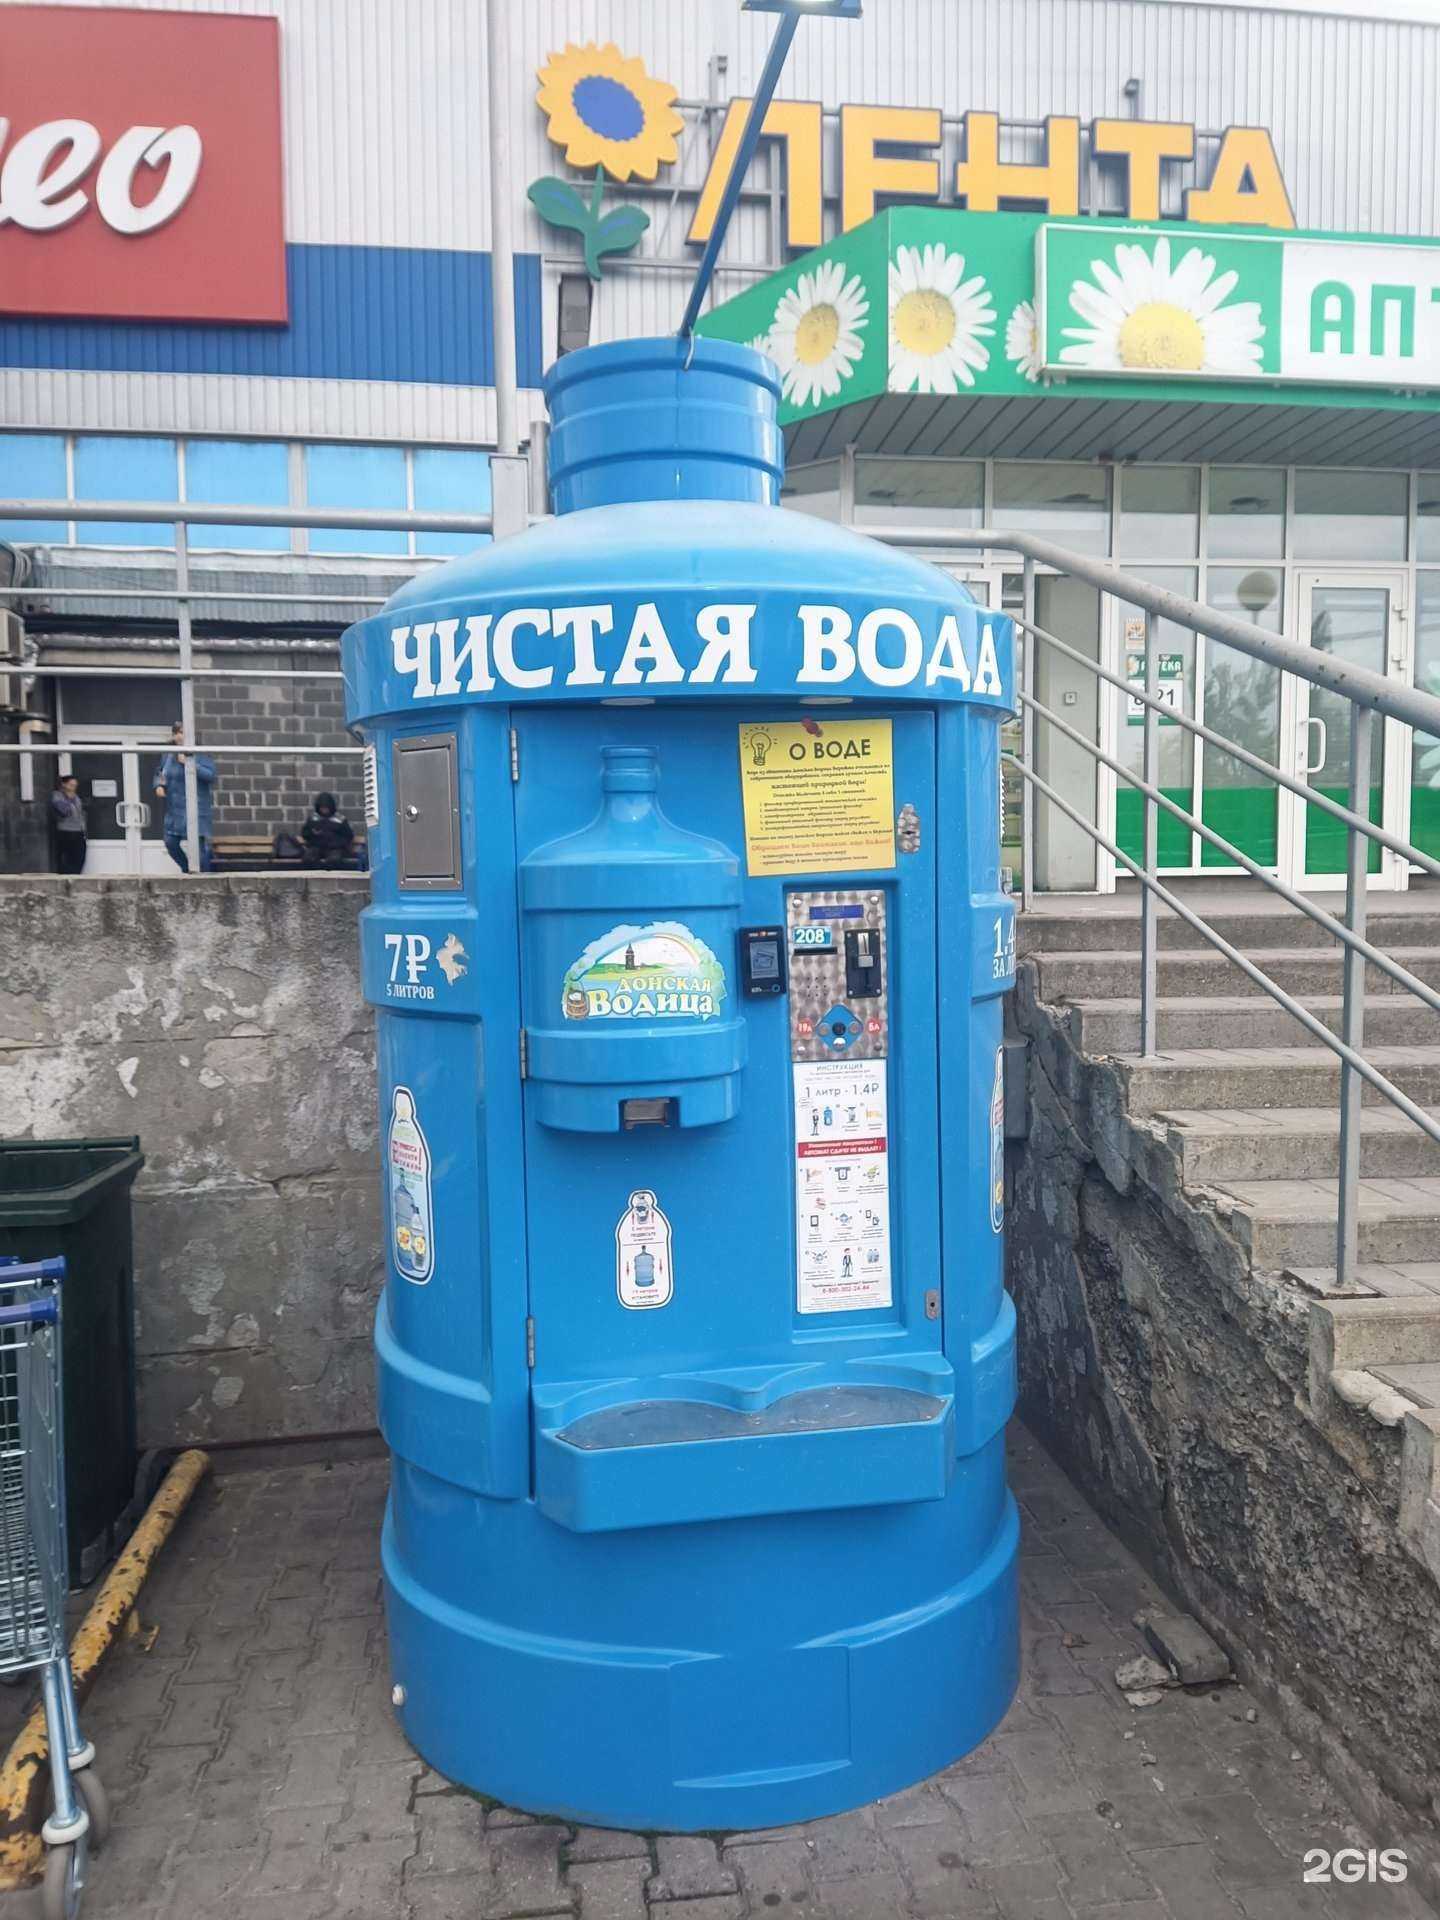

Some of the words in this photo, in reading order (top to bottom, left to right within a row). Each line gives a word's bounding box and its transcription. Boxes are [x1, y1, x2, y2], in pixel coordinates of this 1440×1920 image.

[688, 97, 1297, 248] ЛЕНТА
[1309, 279, 1440, 358] АП
[391, 602, 757, 698] ЧИСТАЯ
[796, 604, 1003, 697] ВОДА
[789, 743, 806, 760] О
[814, 738, 871, 760] ВОДЕ
[795, 928, 825, 944] 208
[393, 984, 435, 999] ЛИТРОВ
[615, 976, 712, 994] ДОНСКАЯ
[587, 989, 714, 1018] Водица
[816, 1063, 863, 1072] ИНСТРУКЦИЯ
[805, 1086, 811, 1098] 1
